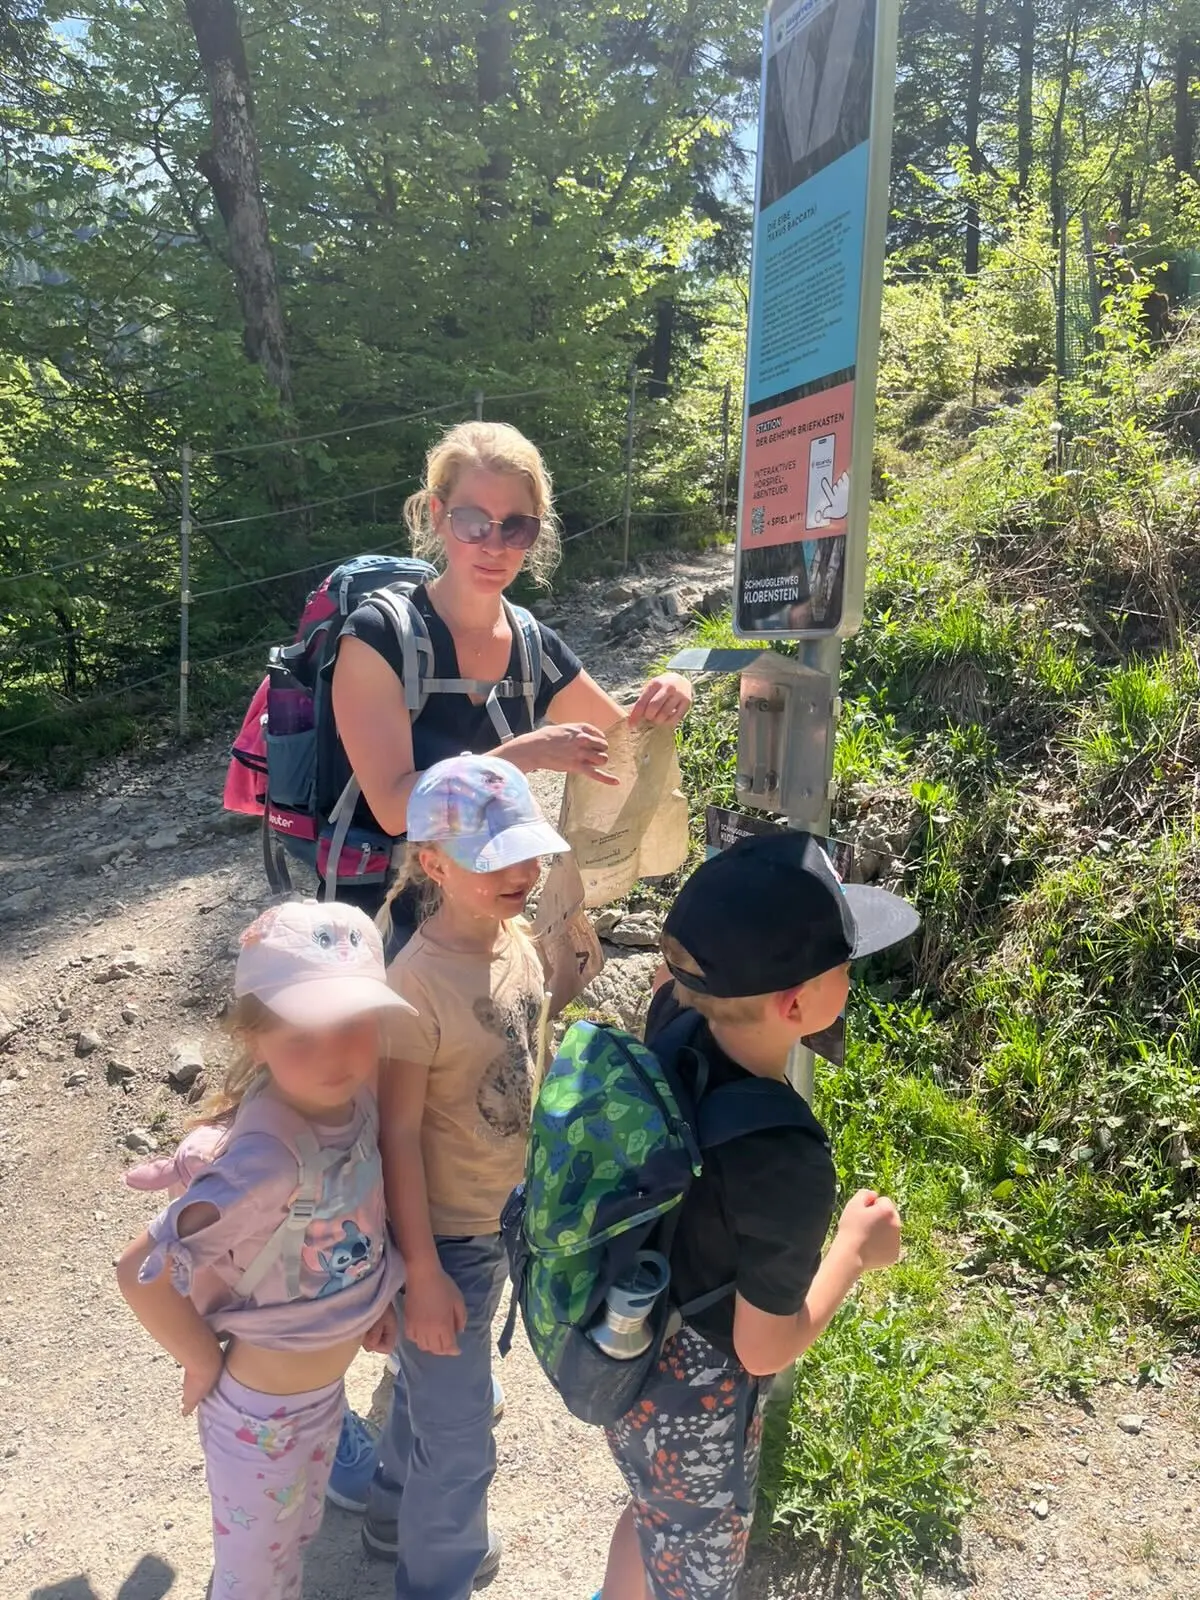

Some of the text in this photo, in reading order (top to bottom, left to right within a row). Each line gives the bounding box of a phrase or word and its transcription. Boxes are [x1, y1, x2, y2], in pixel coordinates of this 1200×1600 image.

[755, 412, 845, 447] DER GEHEIME BRIEFKASTEN
[754, 460, 797, 476] INTERAKTIVES
[753, 485, 788, 499] ABENTEUER
[771, 515, 788, 527] SPIEL
[744, 575, 799, 590] SCHMUGGLERWEG
[743, 587, 799, 604] KLOBENSTEIN
